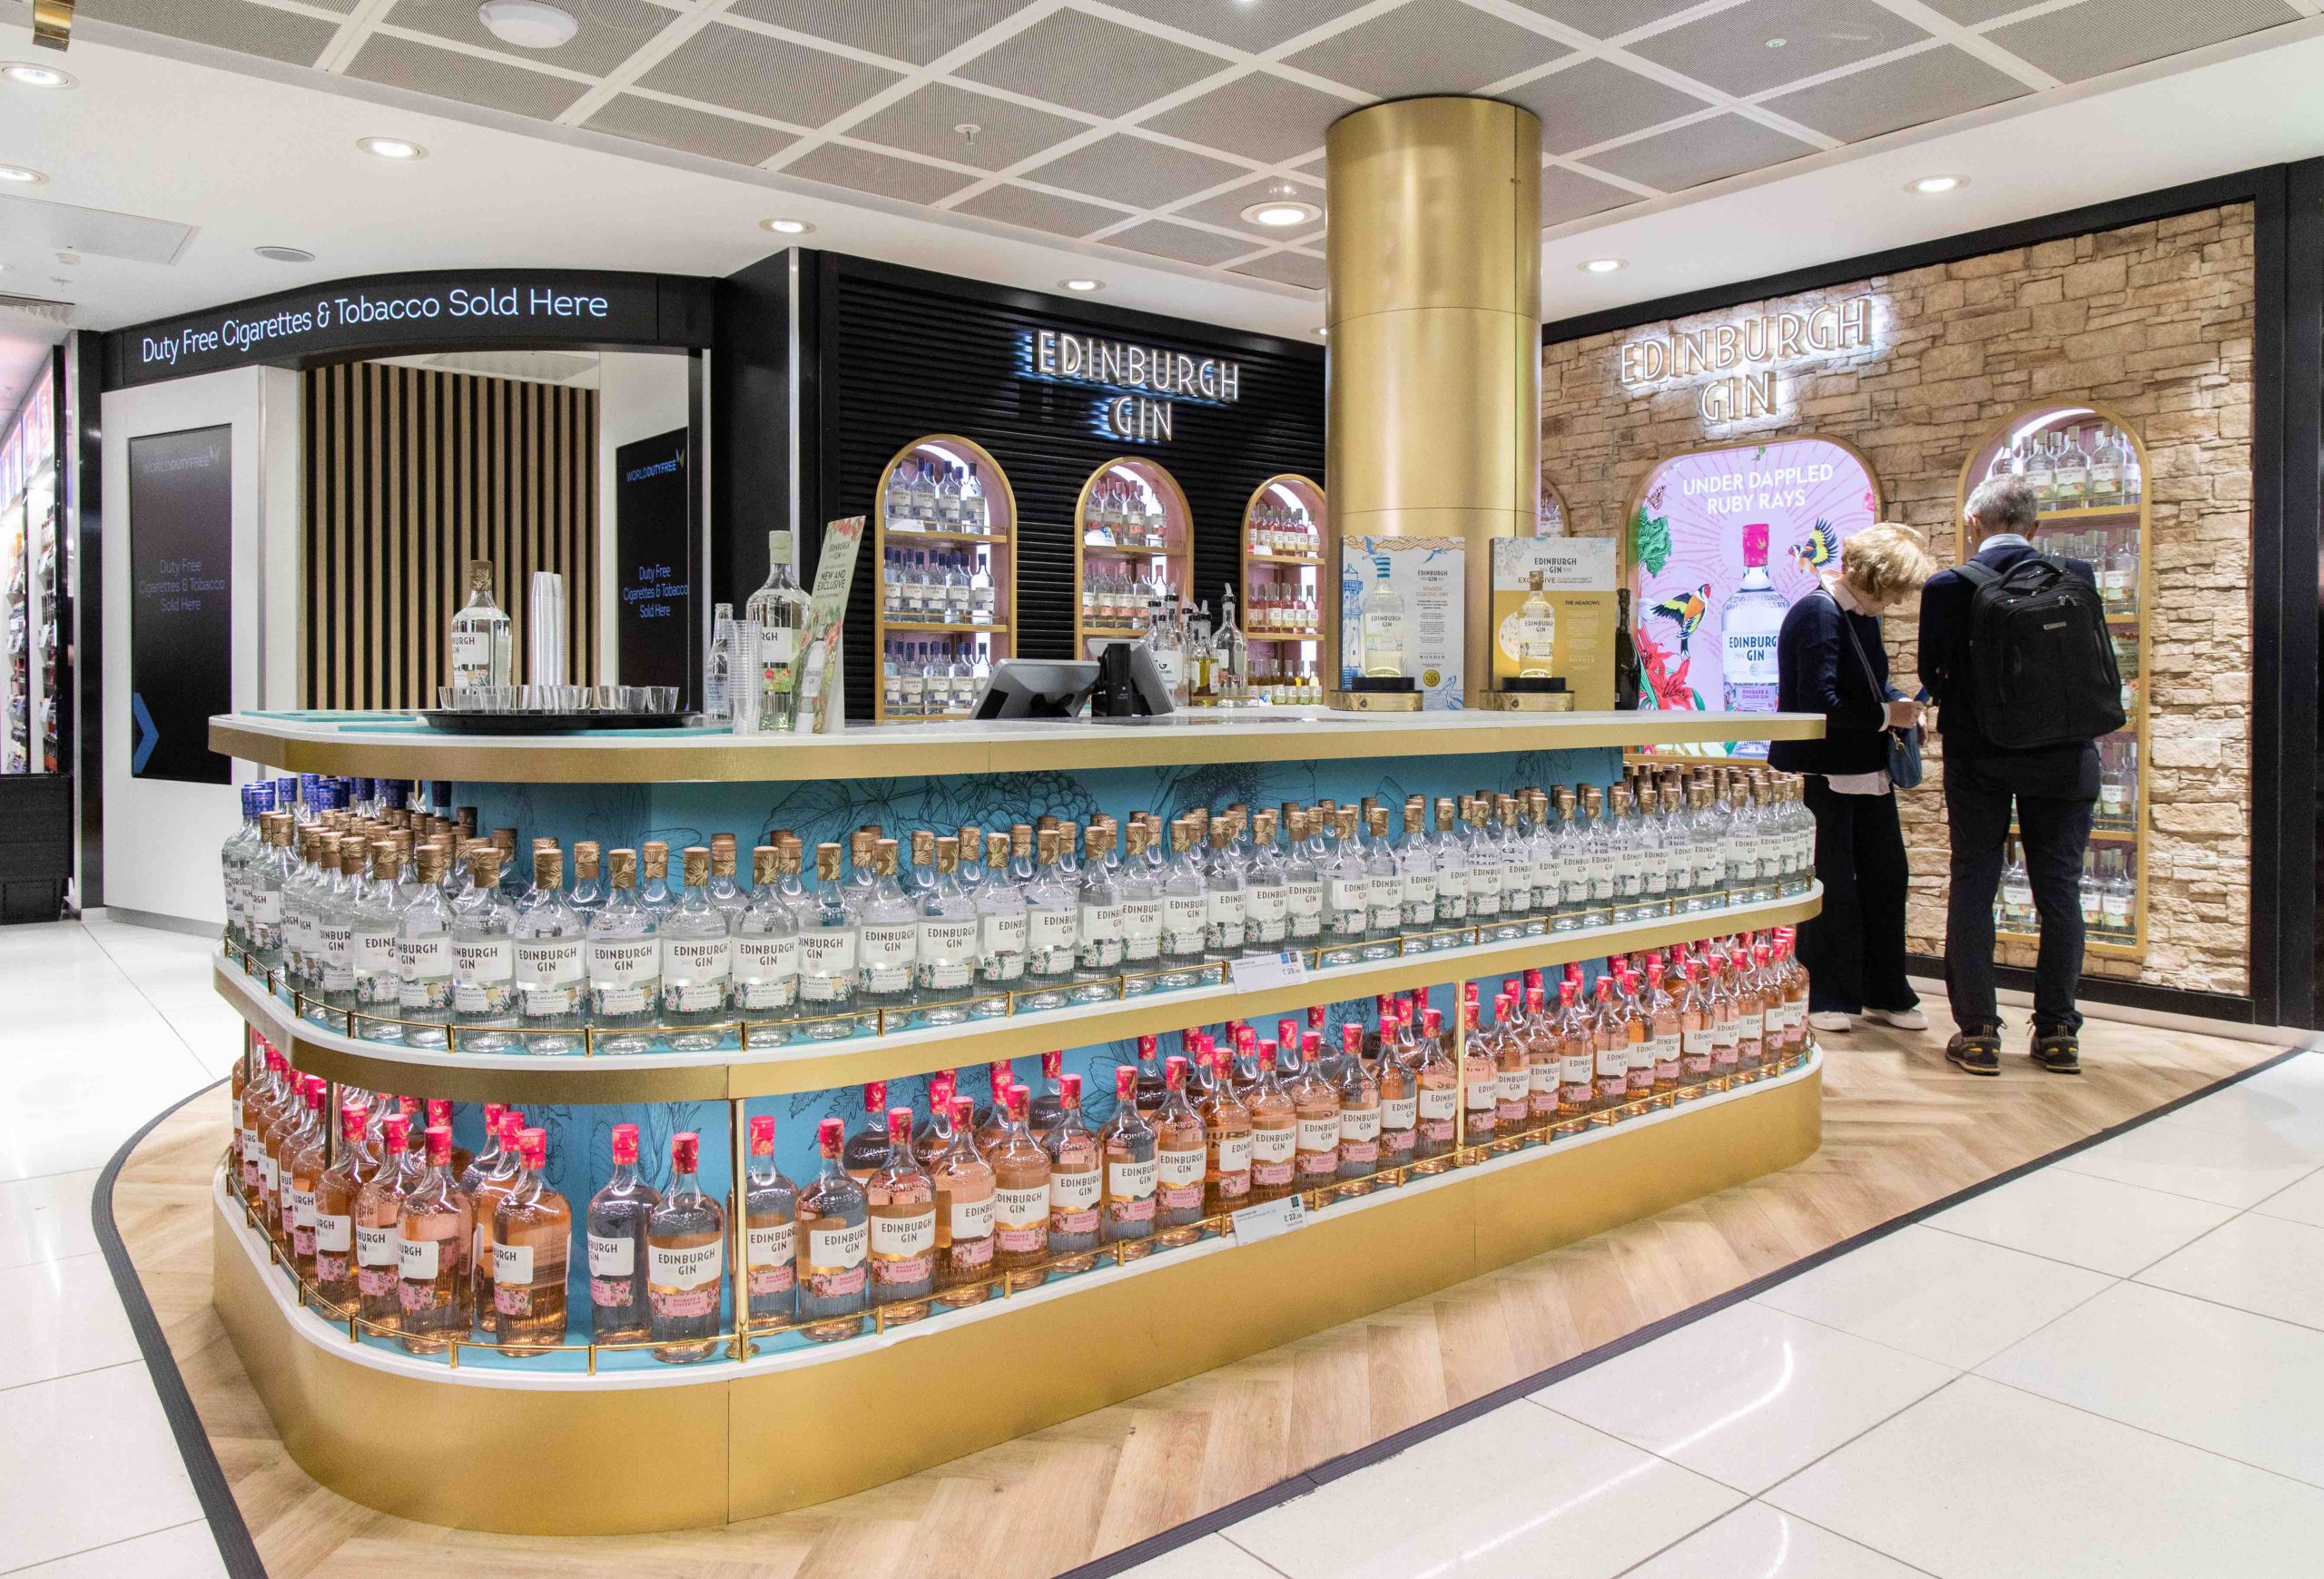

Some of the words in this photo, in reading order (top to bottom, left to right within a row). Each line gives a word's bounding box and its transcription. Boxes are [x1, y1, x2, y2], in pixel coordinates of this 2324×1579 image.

[143, 337, 179, 364] Duty
[183, 330, 218, 354] Free
[222, 312, 311, 351] Cigarettes
[318, 301, 330, 328] &
[335, 295, 439, 324] Tobacco
[449, 288, 518, 316] Sold
[531, 288, 607, 317] Here
[1620, 298, 1870, 384] EDINBURGH
[1035, 331, 1238, 401] EDINBURGH
[1701, 371, 1777, 422] GIN
[1109, 397, 1171, 440] GIN
[1683, 473, 1743, 496] UNDER
[1749, 463, 1833, 489] DAPPLED
[1708, 495, 1753, 515] RUBY
[1758, 489, 1806, 509] RAYS
[160, 560, 180, 577] Duty
[182, 558, 202, 572] Free
[639, 566, 655, 583] Duty
[656, 564, 671, 577] Free
[821, 571, 833, 581] NEW
[834, 569, 845, 578] AND
[139, 580, 180, 597] Cigarettes
[190, 577, 225, 590] Tobacco
[817, 579, 846, 590] EXCLUSIVE
[624, 587, 655, 604] Cigarettes
[656, 584, 660, 597] &
[662, 584, 688, 597] Tobacco
[161, 598, 179, 611] Sold
[182, 597, 201, 610] Here
[640, 605, 654, 617] Sold
[655, 604, 671, 617] Here
[452, 637, 476, 646] BURGH
[1729, 637, 1777, 648] EDINBURG
[1747, 650, 1764, 661] GIN
[1387, 888, 1398, 896] GIN
[1274, 898, 1284, 907] GIN
[1305, 894, 1316, 903] GIN
[1140, 914, 1154, 923] GIN
[1187, 909, 1199, 918] GIN
[1061, 925, 1073, 934] GIN
[865, 930, 915, 941] EDINBURGH
[329, 942, 344, 951] GIN
[740, 942, 794, 954] EDINBURGH
[884, 942, 901, 952] GIN
[946, 939, 962, 948] GIN
[519, 947, 576, 961] EDINBURGH
[595, 946, 653, 960] EDINBURGH
[674, 942, 727, 956] EDINBURGH
[807, 950, 822, 959] GIN
[401, 955, 415, 965] GIN
[460, 960, 475, 970] GIN
[695, 957, 713, 967] GIN
[760, 955, 777, 965] GIN
[537, 962, 556, 972] GIN
[615, 961, 633, 970] GIN
[1509, 1082, 1520, 1090] GIN
[1321, 1131, 1333, 1140] GIN
[1272, 1142, 1285, 1150] GIN
[1160, 1153, 1204, 1164] EDINBURGH
[1177, 1164, 1191, 1173] GIN
[1139, 1175, 1151, 1184] GIN
[1079, 1187, 1092, 1196] GIN
[1009, 1204, 1025, 1213] GIN
[982, 1213, 993, 1224] GIN
[881, 1219, 931, 1233] EDINBURGH
[751, 1228, 795, 1244] EDINBURG
[901, 1233, 917, 1243] GIN
[772, 1243, 787, 1253] GIN
[845, 1244, 860, 1253] GIN
[658, 1248, 715, 1264] EDINBURGH
[678, 1265, 696, 1275] GIN
